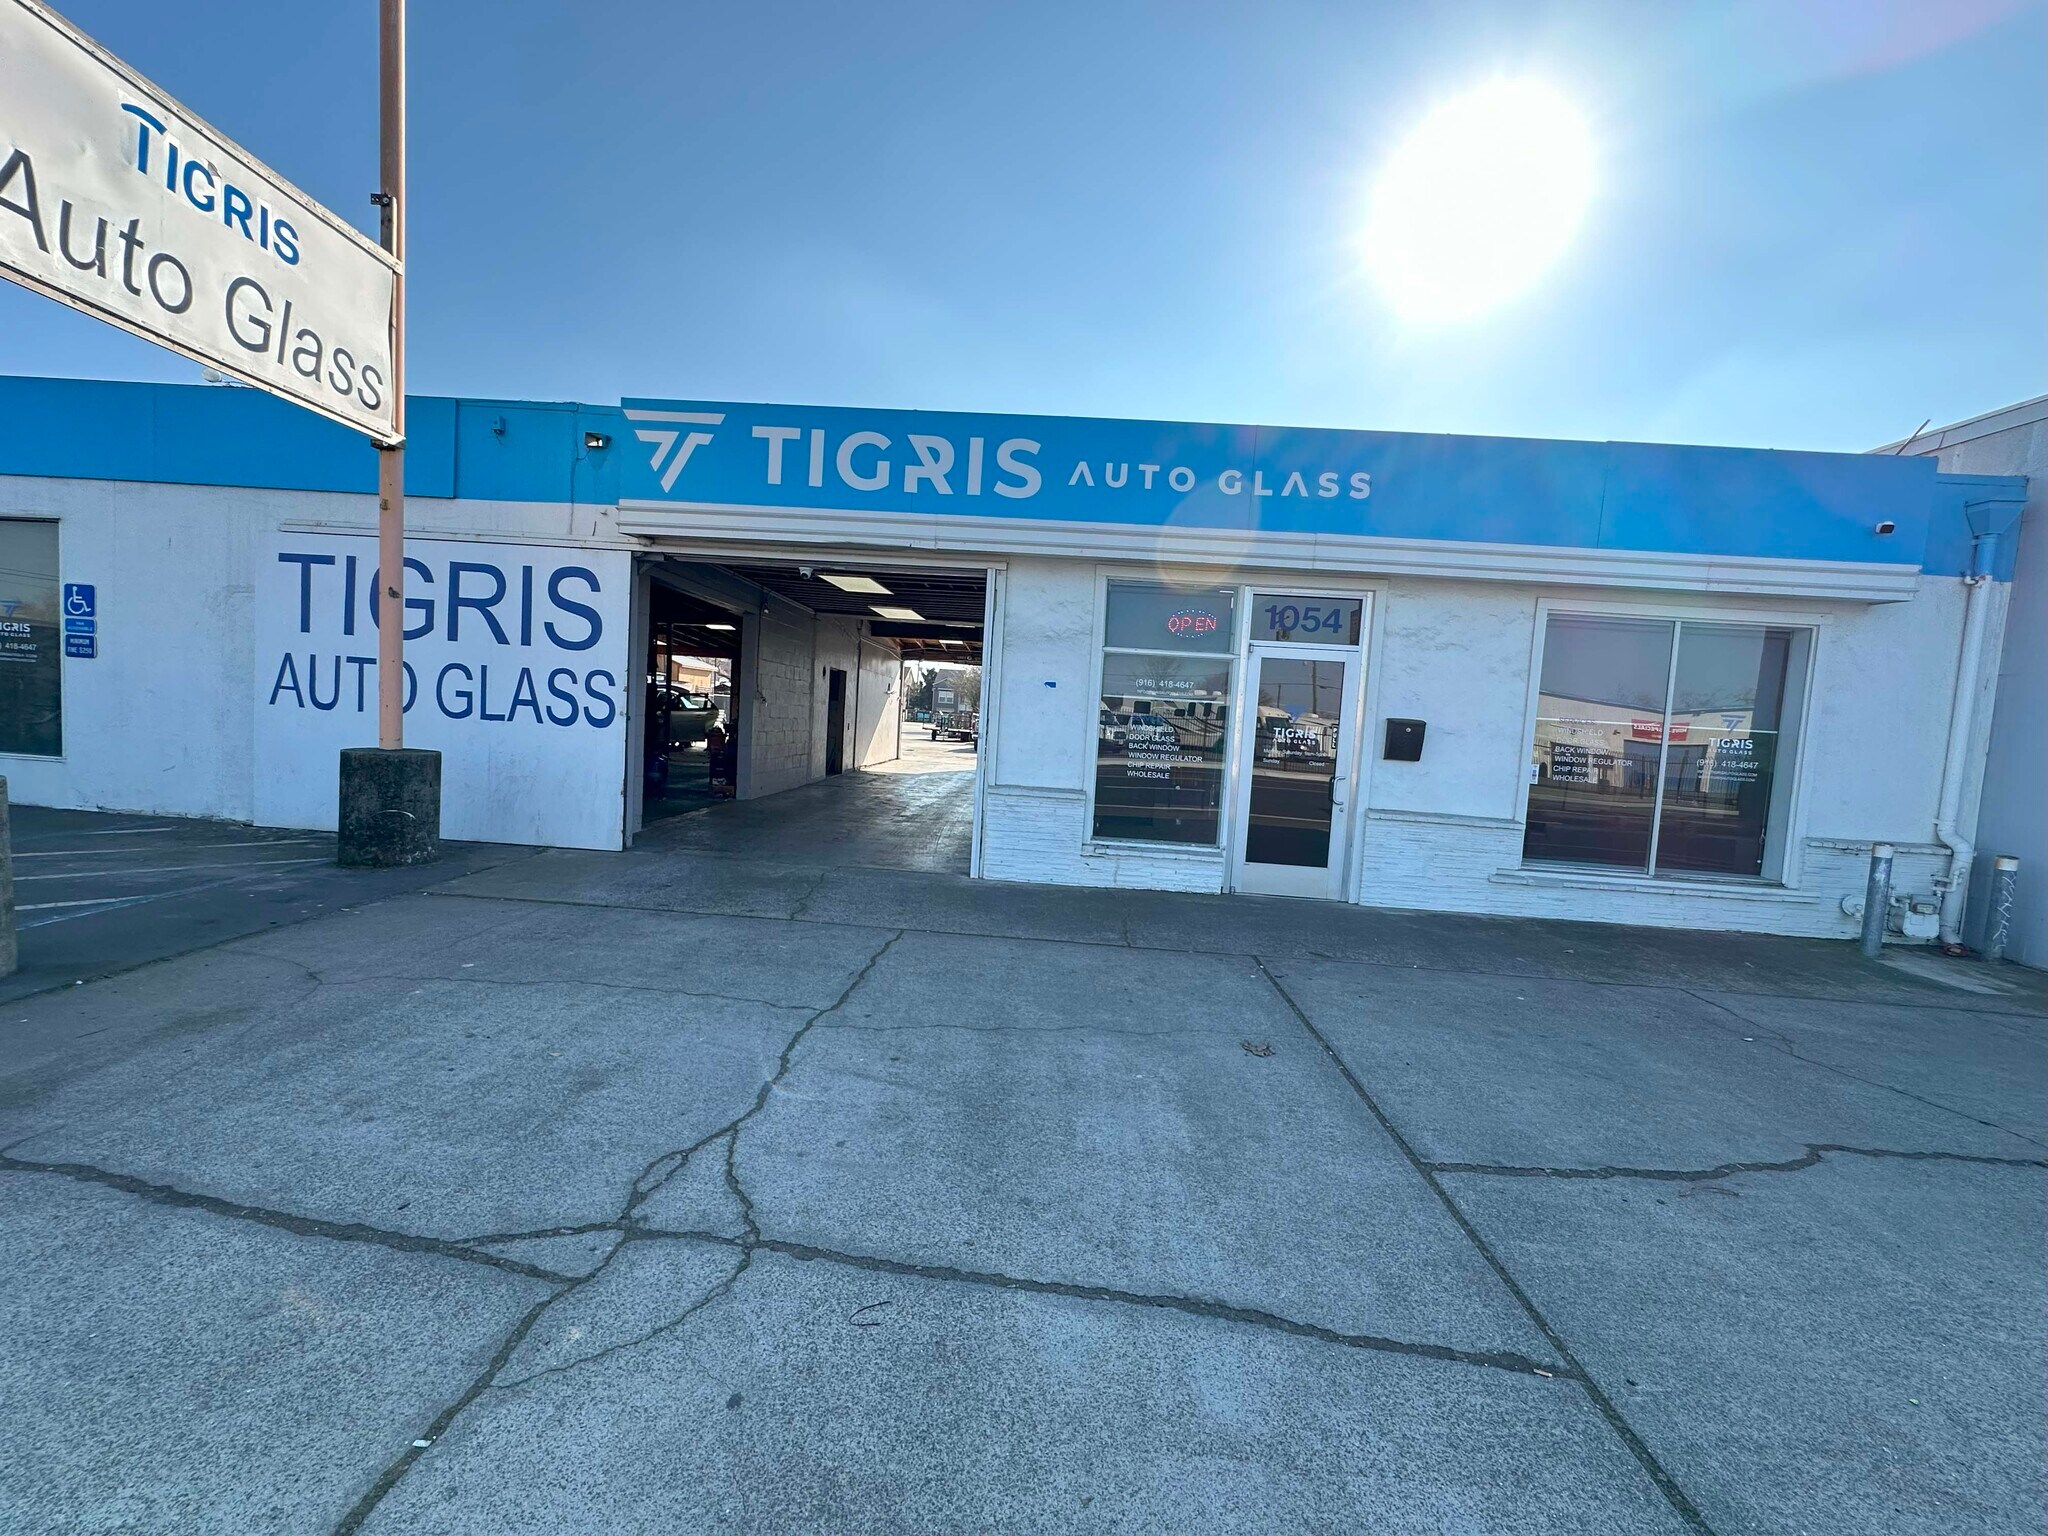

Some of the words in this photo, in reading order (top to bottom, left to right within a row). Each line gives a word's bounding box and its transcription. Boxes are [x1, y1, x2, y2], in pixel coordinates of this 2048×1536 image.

[121, 102, 300, 267] TIGRIS
[0, 148, 193, 315] Auto
[226, 275, 383, 412] Glass
[752, 426, 1042, 499] TIGRIS
[1068, 461, 1196, 492] AUTO
[1218, 469, 1371, 500] GLASS
[278, 552, 603, 651] TIGRIS
[1168, 615, 1217, 632] OPEN
[1265, 605, 1343, 633] 1054
[0, 622, 31, 632] IGRIS
[1136, 679, 1156, 688] (916)
[1159, 680, 1194, 689] 418-4647
[436, 662, 616, 728] GLASS
[1130, 725, 1174, 733] WINDSHIELD
[1273, 727, 1317, 739] TIGRIS
[1152, 735, 1175, 743] GLASS
[1709, 737, 1753, 749] TIGRIS
[1149, 744, 1180, 752] WINDOW
[1577, 747, 1609, 756] WINDOW
[1128, 752, 1159, 760] WINDOW
[1160, 754, 1203, 763] REGULATOR
[1554, 755, 1587, 763] WINDOW
[1588, 757, 1633, 766] REGULATOR
[1145, 762, 1171, 770] REPAIR
[1721, 760, 1759, 769] 418-4647
[1127, 770, 1170, 779] WHOLESALE
[1572, 766, 1599, 774] REPAIR
[1552, 774, 1598, 784] WHOLESALE
